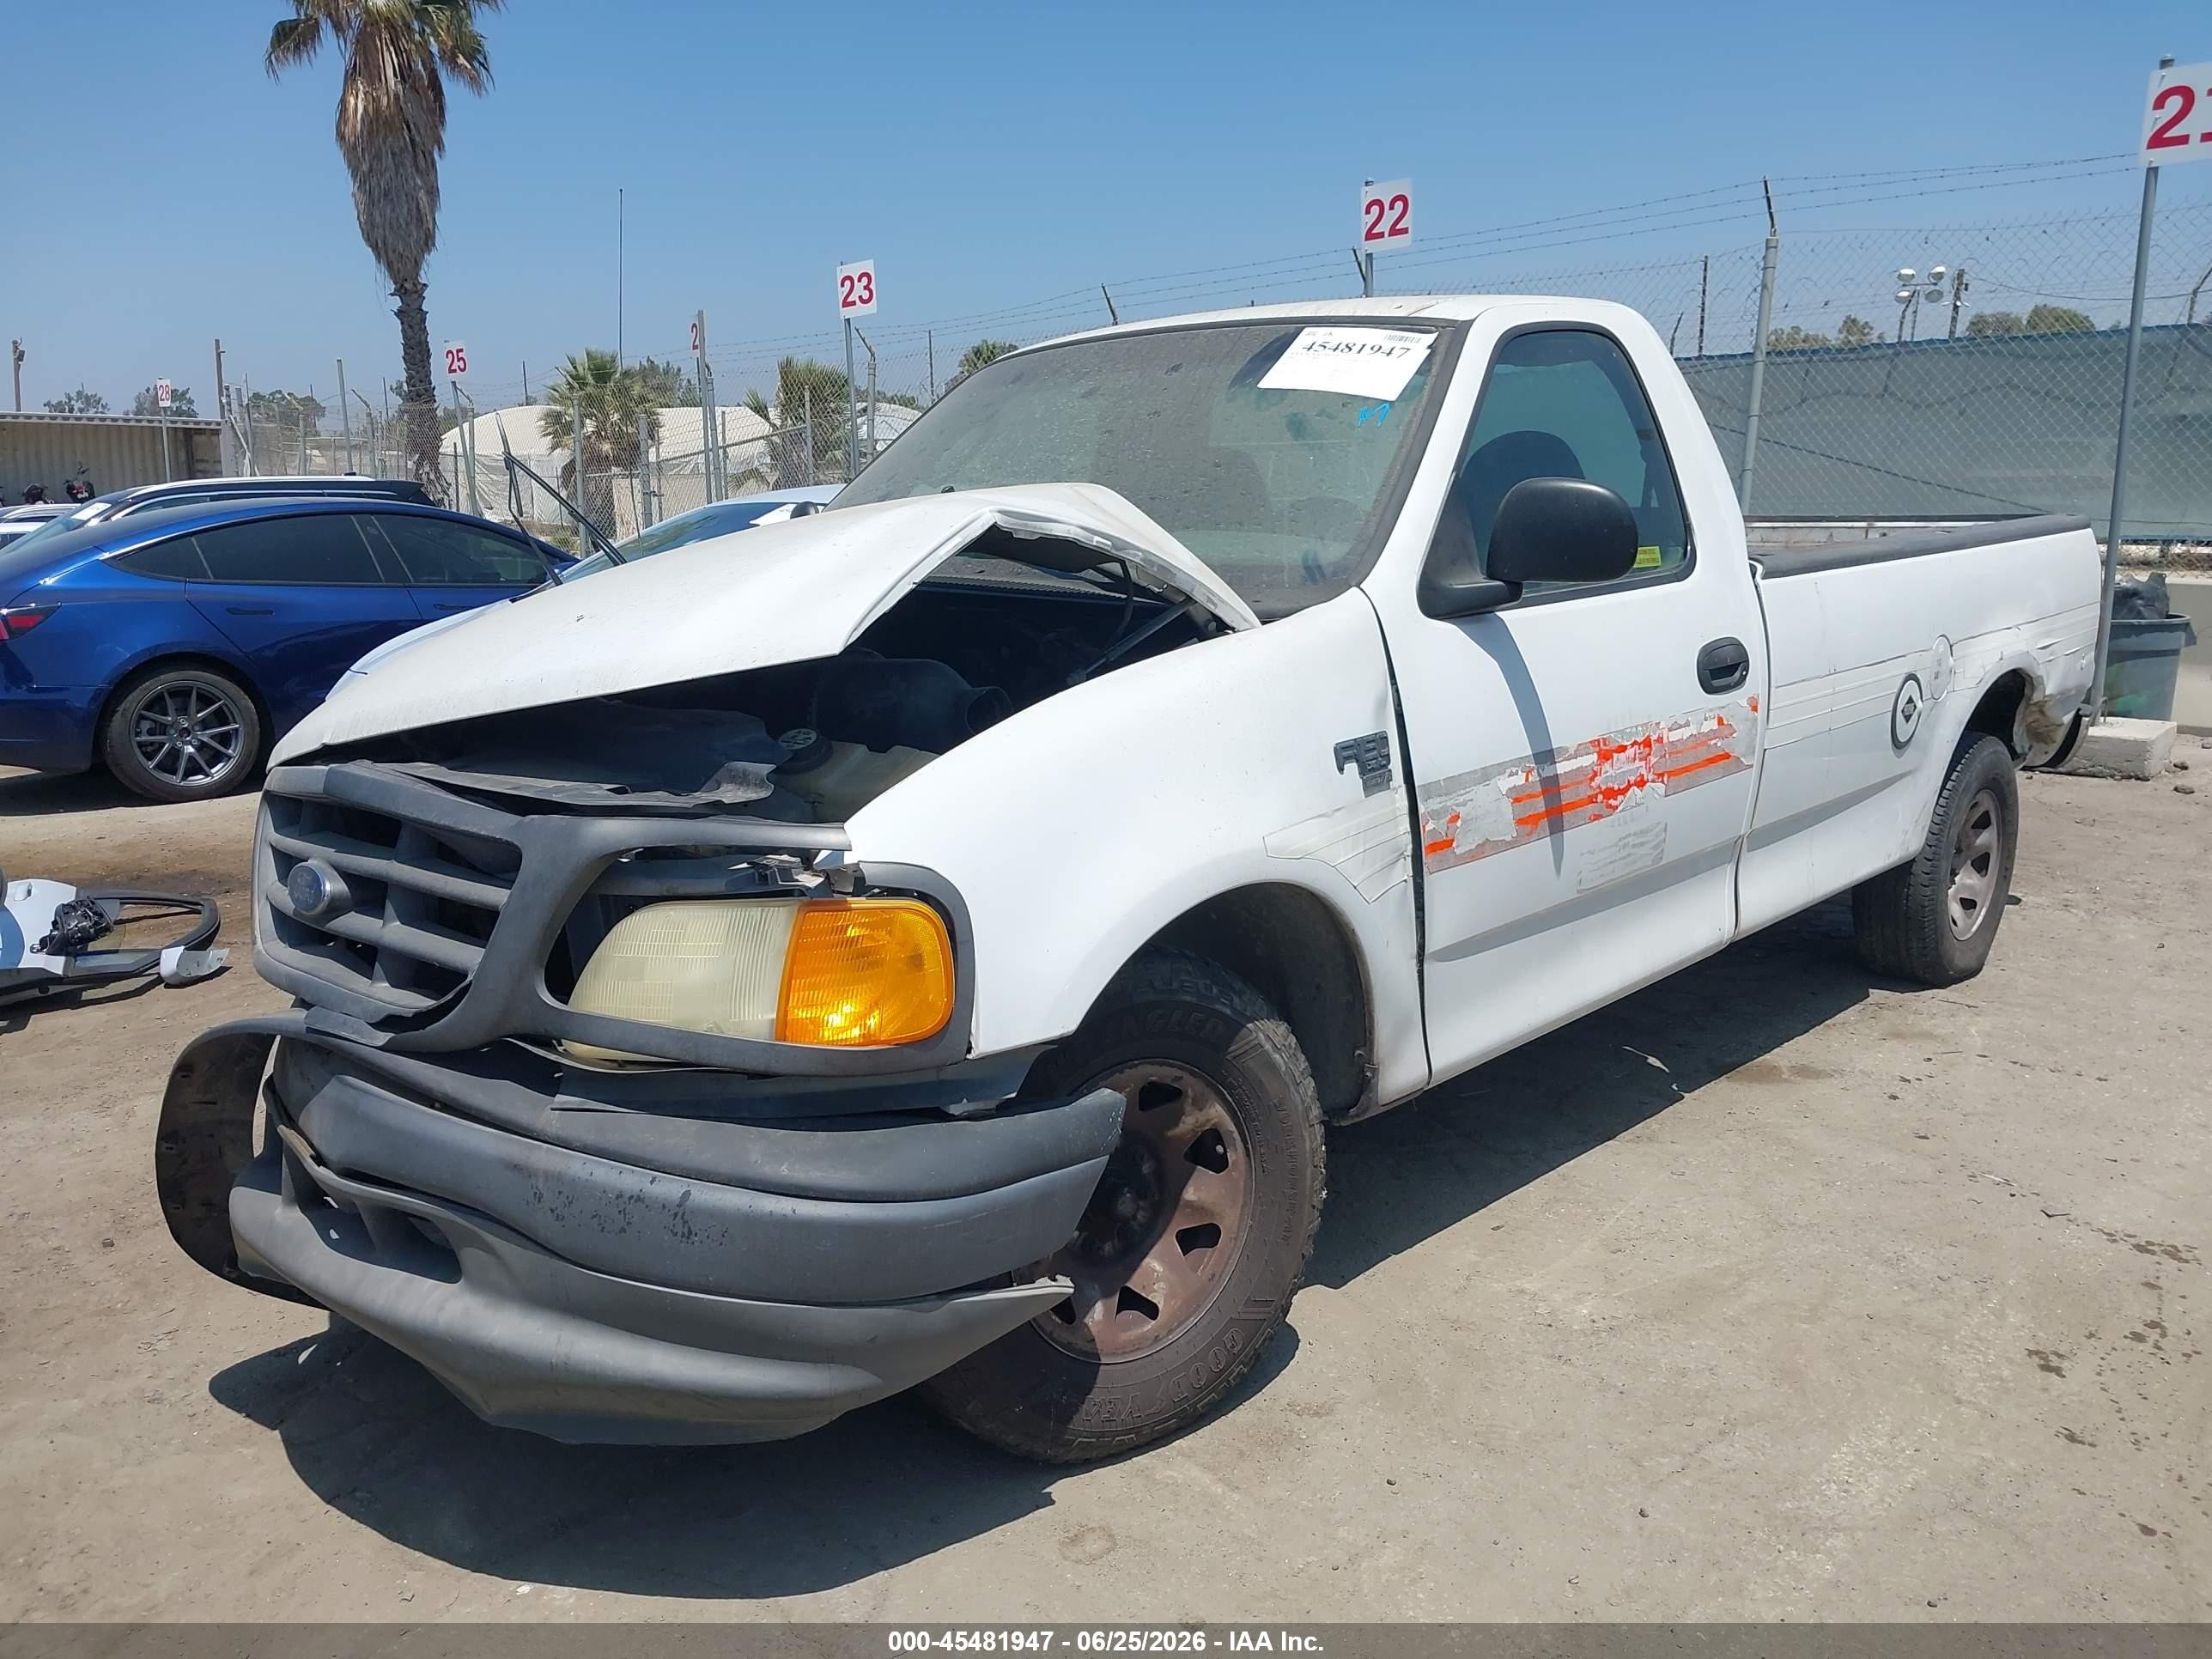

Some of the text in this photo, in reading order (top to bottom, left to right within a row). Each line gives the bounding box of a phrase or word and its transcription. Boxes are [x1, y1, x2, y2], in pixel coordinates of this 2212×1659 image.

[1364, 194, 1409, 241] 22
[839, 270, 874, 309] 23
[690, 322, 700, 351] 2
[1302, 341, 1411, 359] 45481947
[445, 348, 466, 374] 25
[158, 384, 170, 401] 28
